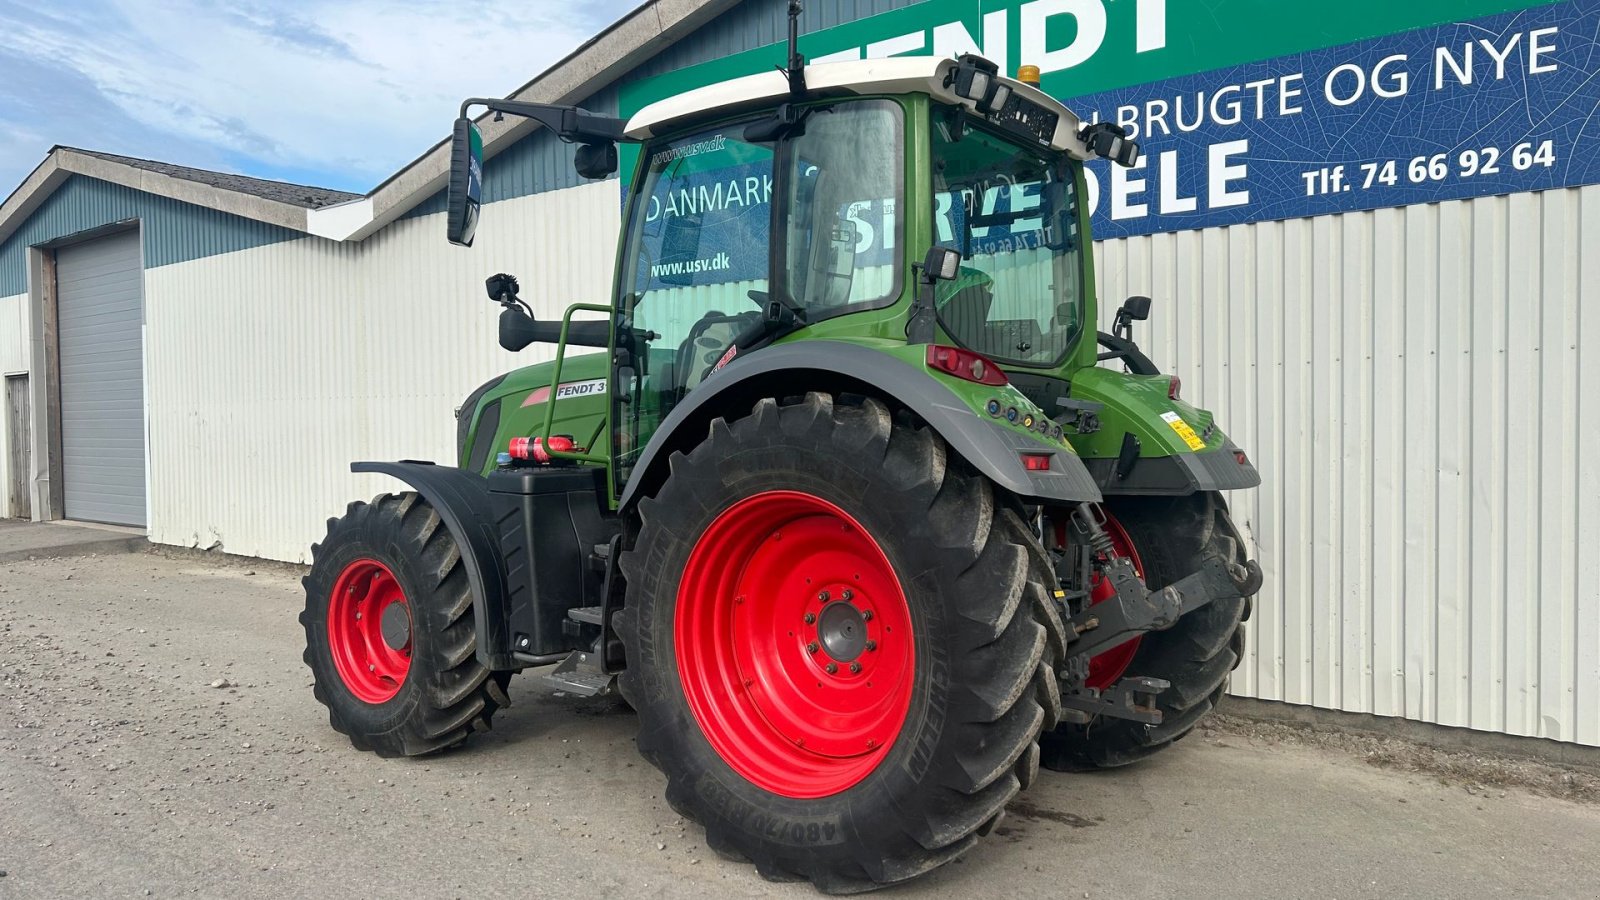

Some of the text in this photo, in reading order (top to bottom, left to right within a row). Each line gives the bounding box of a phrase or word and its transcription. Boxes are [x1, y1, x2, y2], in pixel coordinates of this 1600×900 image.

[1117, 27, 1557, 141] BRUGTE OG NYE
[652, 134, 726, 165] www.usv.dk
[1302, 140, 1556, 196] Tlf. 74 66 92 64
[650, 252, 730, 278] www.usv.dk
[557, 384, 595, 397] FENDT
